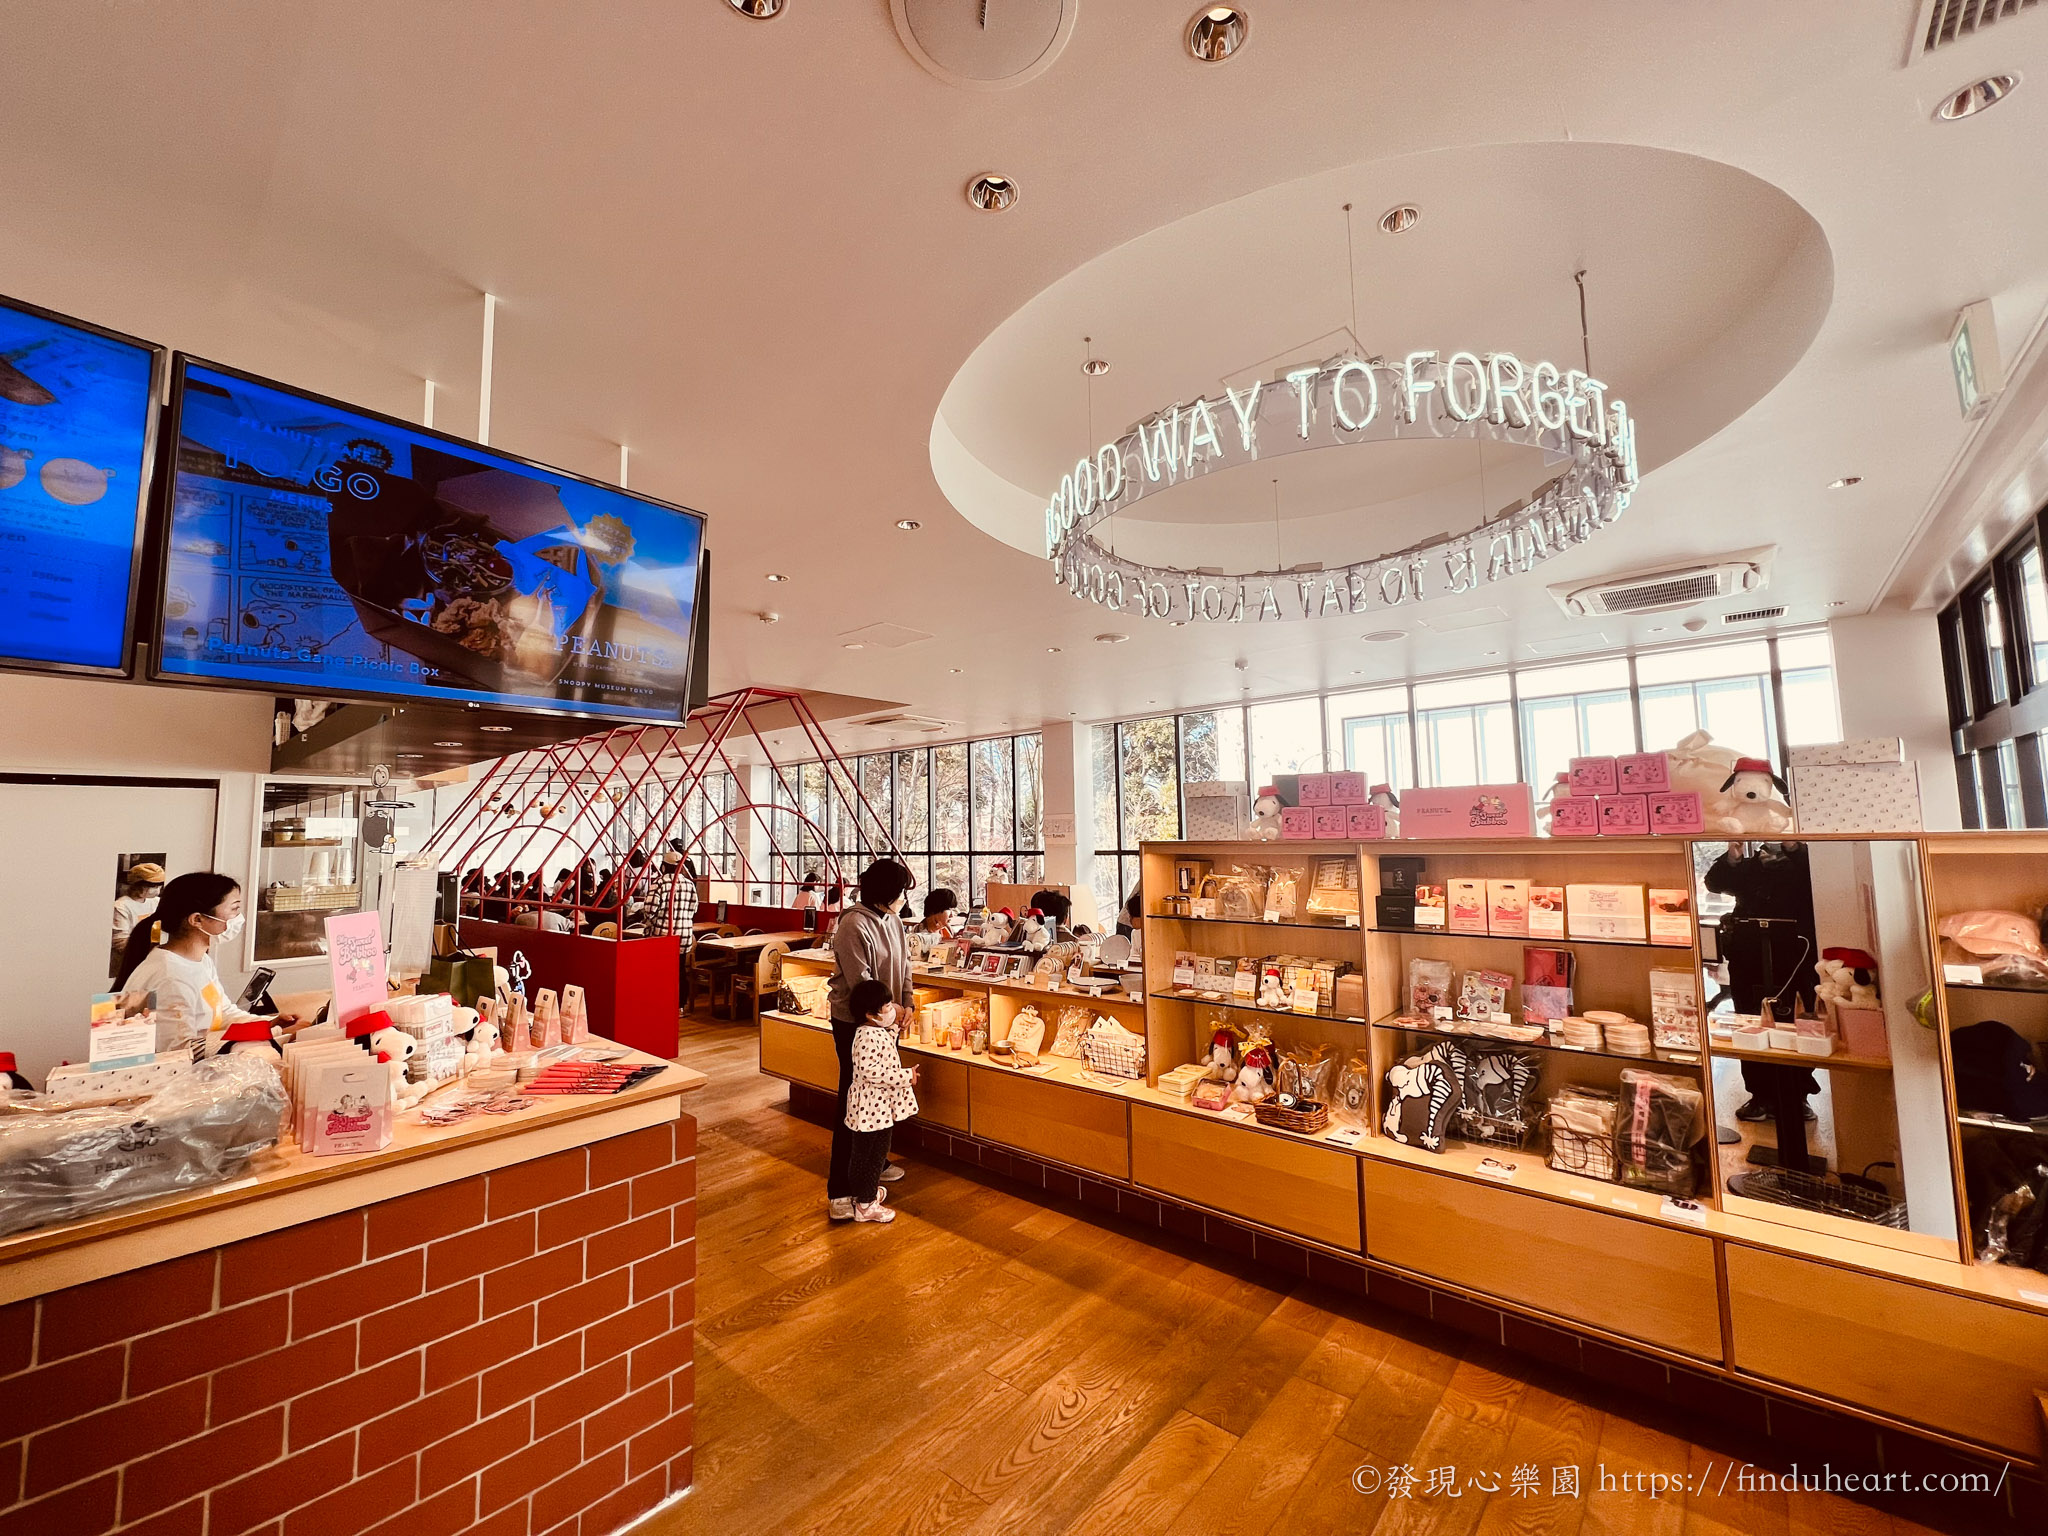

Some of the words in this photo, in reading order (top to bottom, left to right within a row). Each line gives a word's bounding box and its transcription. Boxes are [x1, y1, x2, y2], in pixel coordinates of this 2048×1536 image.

[239, 416, 321, 448] PEANUTS
[1050, 444, 1122, 544] GOOD
[1138, 380, 1261, 482] WAY
[1286, 361, 1378, 440] TO
[1404, 350, 1609, 446] FORGET
[208, 637, 290, 661] Peanuts
[297, 649, 345, 668] Gang
[352, 654, 403, 673] Picnic
[410, 662, 439, 677] Box
[553, 634, 666, 667] PEANUTS
[558, 678, 591, 688] SNOOPY
[594, 683, 627, 692] MUSEUM
[629, 687, 654, 695] TOKYO
[94, 1152, 166, 1174] PEANUTS
